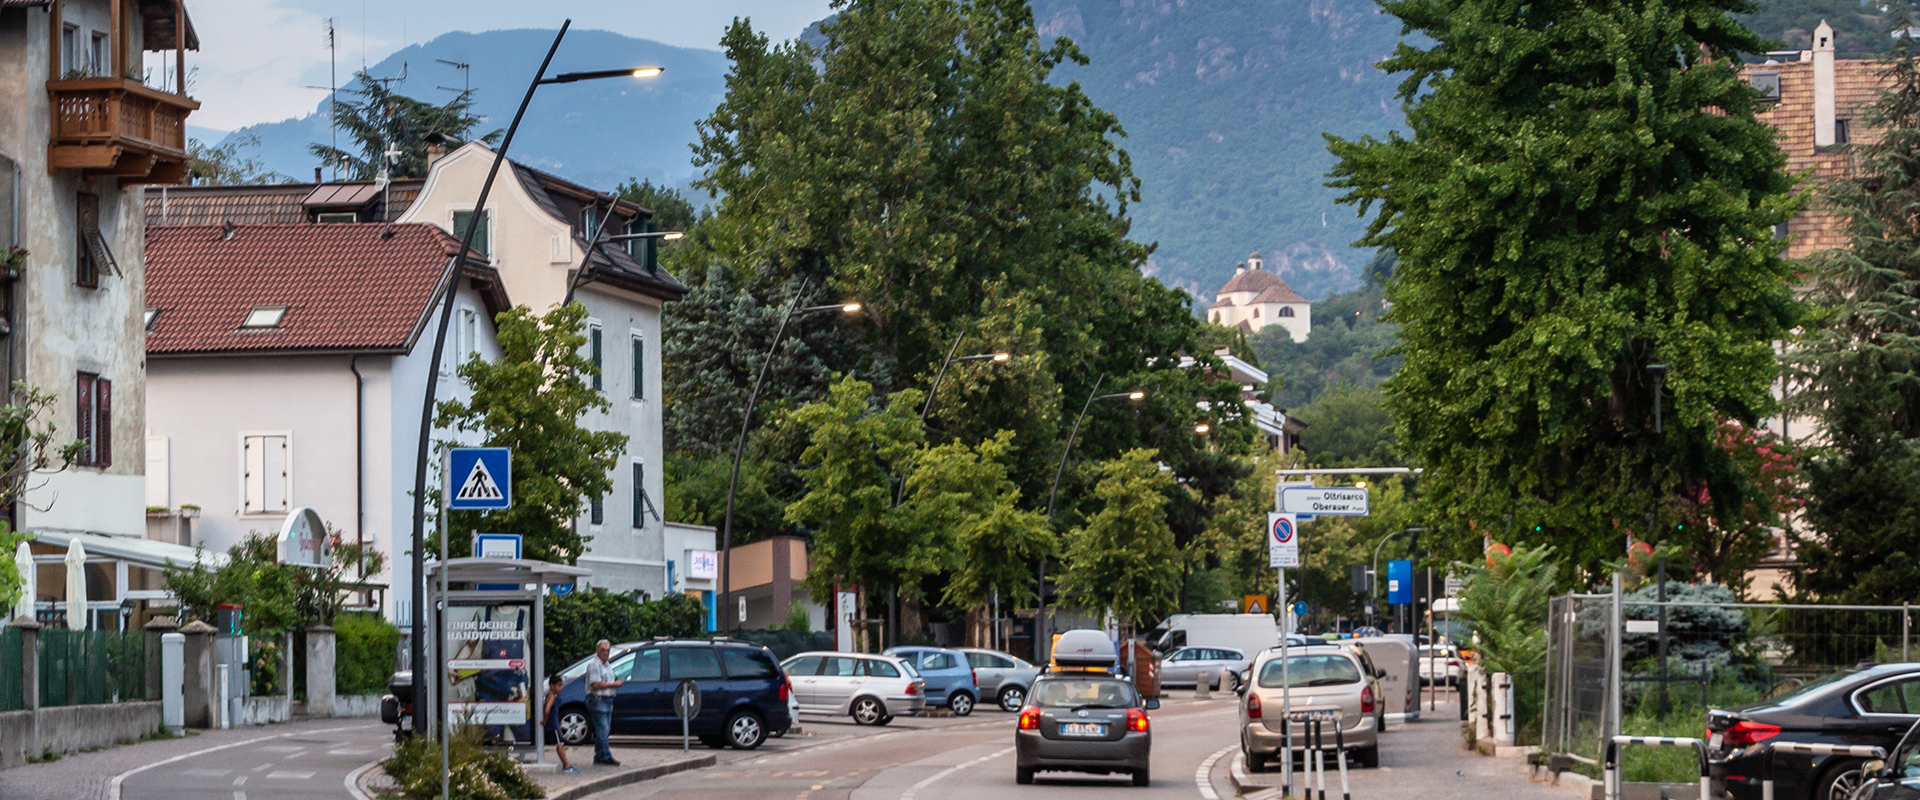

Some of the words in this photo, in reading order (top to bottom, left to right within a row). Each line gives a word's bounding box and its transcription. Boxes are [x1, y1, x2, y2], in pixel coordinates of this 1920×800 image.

[1323, 491, 1364, 500] Oltrisarco
[1312, 502, 1350, 511] Oberauer
[447, 621, 478, 630] FINDE
[480, 621, 517, 630] DEINEN
[447, 631, 525, 640] HANDWERKER
